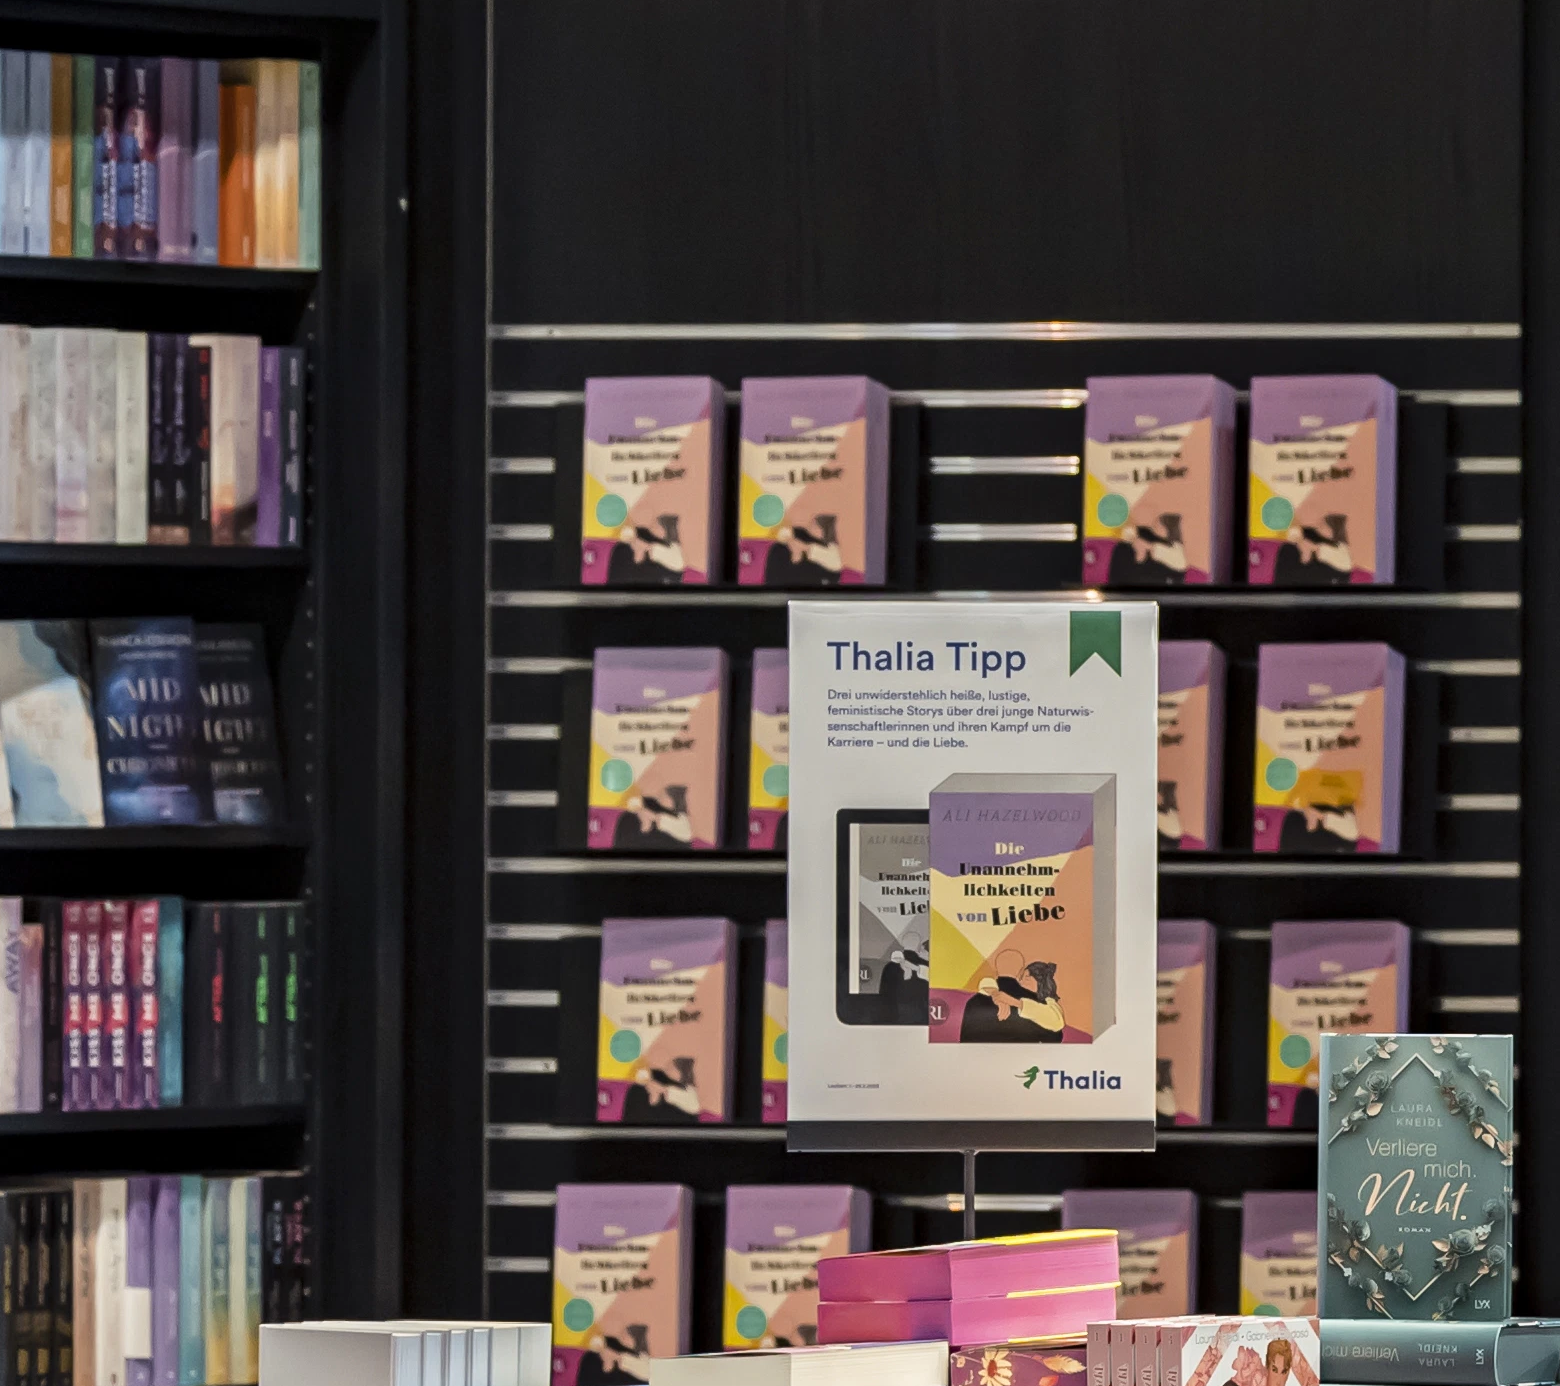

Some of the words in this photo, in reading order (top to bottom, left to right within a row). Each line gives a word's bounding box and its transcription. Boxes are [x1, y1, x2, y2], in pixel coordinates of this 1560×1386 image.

[827, 641, 934, 672] Thalia
[946, 641, 1027, 678] Tipp
[828, 689, 852, 701] Drei
[855, 688, 948, 702] unwiderstehlich
[950, 689, 986, 703] heiße,
[988, 690, 1031, 705] lustige,
[827, 704, 904, 717] feministische
[906, 705, 944, 719] Storys
[946, 704, 973, 718] über
[976, 705, 999, 718] drei
[1001, 705, 1035, 720] junge
[1037, 706, 1095, 718] Naturwis-
[827, 721, 930, 733] senschaftlerinnen
[932, 721, 956, 733] und
[958, 721, 988, 733] ihren
[990, 721, 1029, 735] Kampf
[1032, 723, 1051, 733] um
[1053, 721, 1072, 733] die
[827, 736, 874, 748] Karriere
[887, 736, 910, 748] und
[912, 736, 931, 748] die
[933, 736, 969, 749] Liebe.
[942, 809, 972, 822] ALI
[977, 809, 1082, 823] HAZELWOOD
[995, 842, 1025, 855] Die
[959, 862, 1060, 877] Unannehm-
[963, 883, 1055, 897] lichkeiten
[956, 911, 987, 923] von
[991, 903, 1066, 926] Liebe
[1043, 1070, 1122, 1091] Thalia
[1390, 1103, 1433, 1113] LAURA
[1396, 1117, 1444, 1127] KNEIDL
[1365, 1138, 1438, 1157] Verliere
[1424, 1160, 1477, 1178] mich.
[1357, 1169, 1473, 1221] Nicht.
[1474, 1299, 1491, 1310] LYX
[1351, 1346, 1400, 1362] Verliere
[1417, 1344, 1458, 1353] KNEIDL
[1418, 1357, 1455, 1367] LAURA
[1475, 1349, 1485, 1365] LYX
